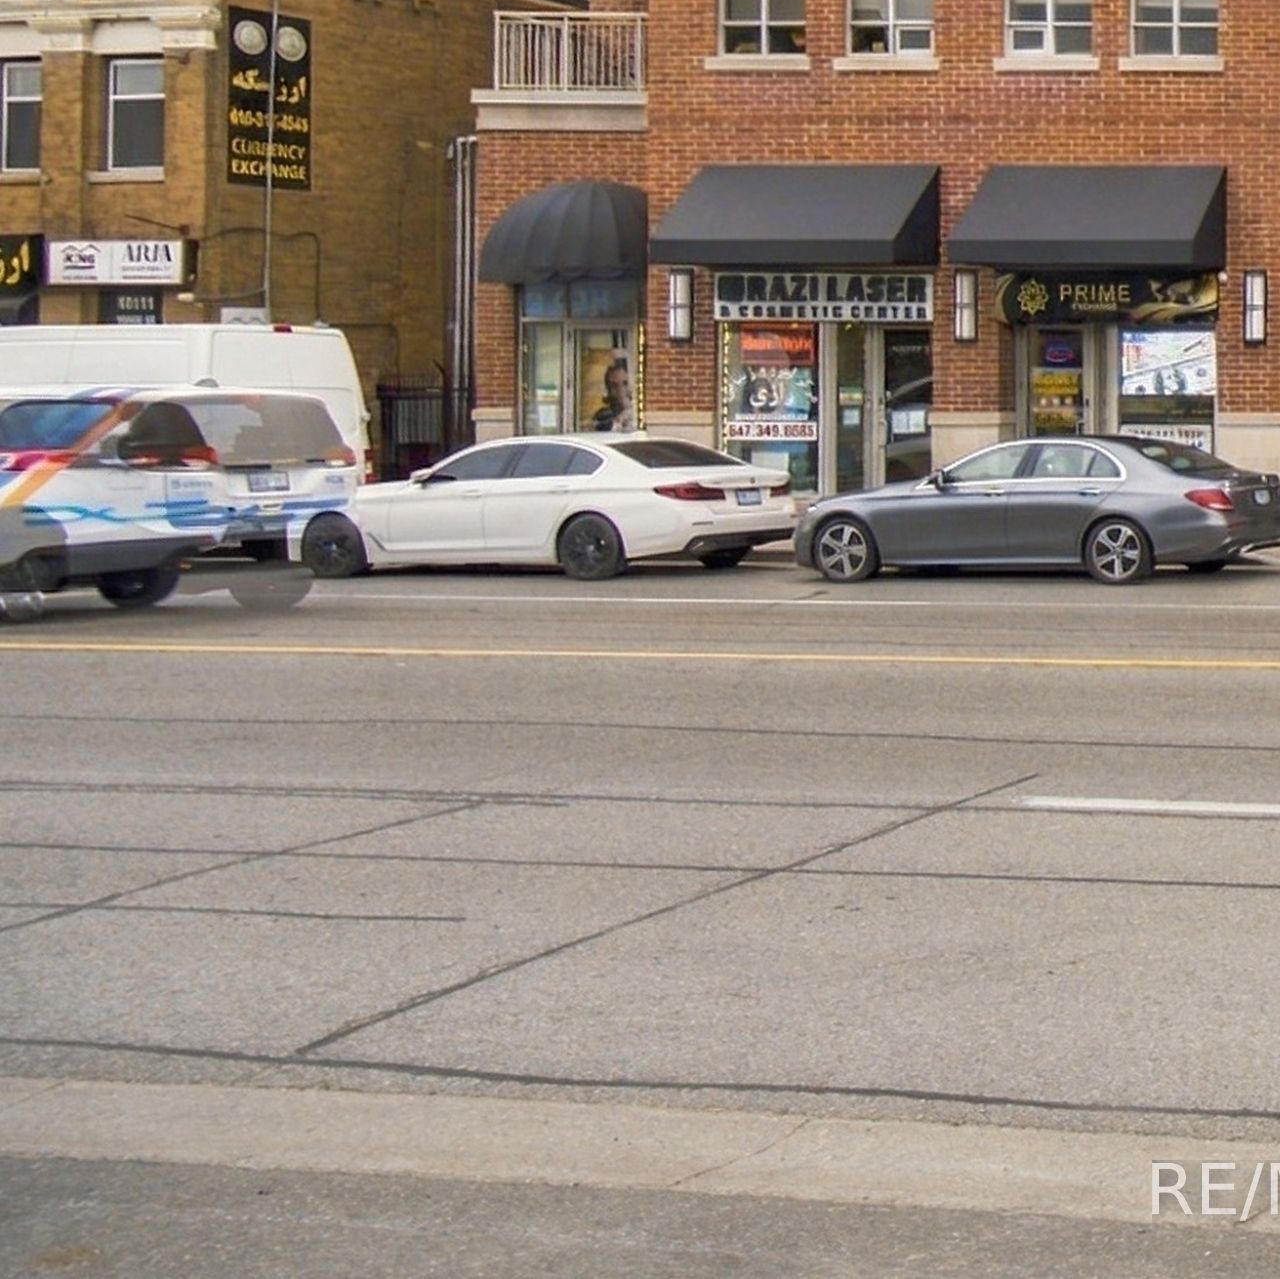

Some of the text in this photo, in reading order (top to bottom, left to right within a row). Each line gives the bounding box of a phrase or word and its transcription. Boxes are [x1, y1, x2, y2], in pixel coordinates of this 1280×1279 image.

[232, 138, 305, 160] CURRENCY
[231, 159, 306, 180] EXCHANGE
[747, 275, 927, 304] RAZI LASER
[1059, 284, 1131, 303] PRIME
[739, 305, 844, 319] COSMETIC
[851, 306, 927, 320] CENTER
